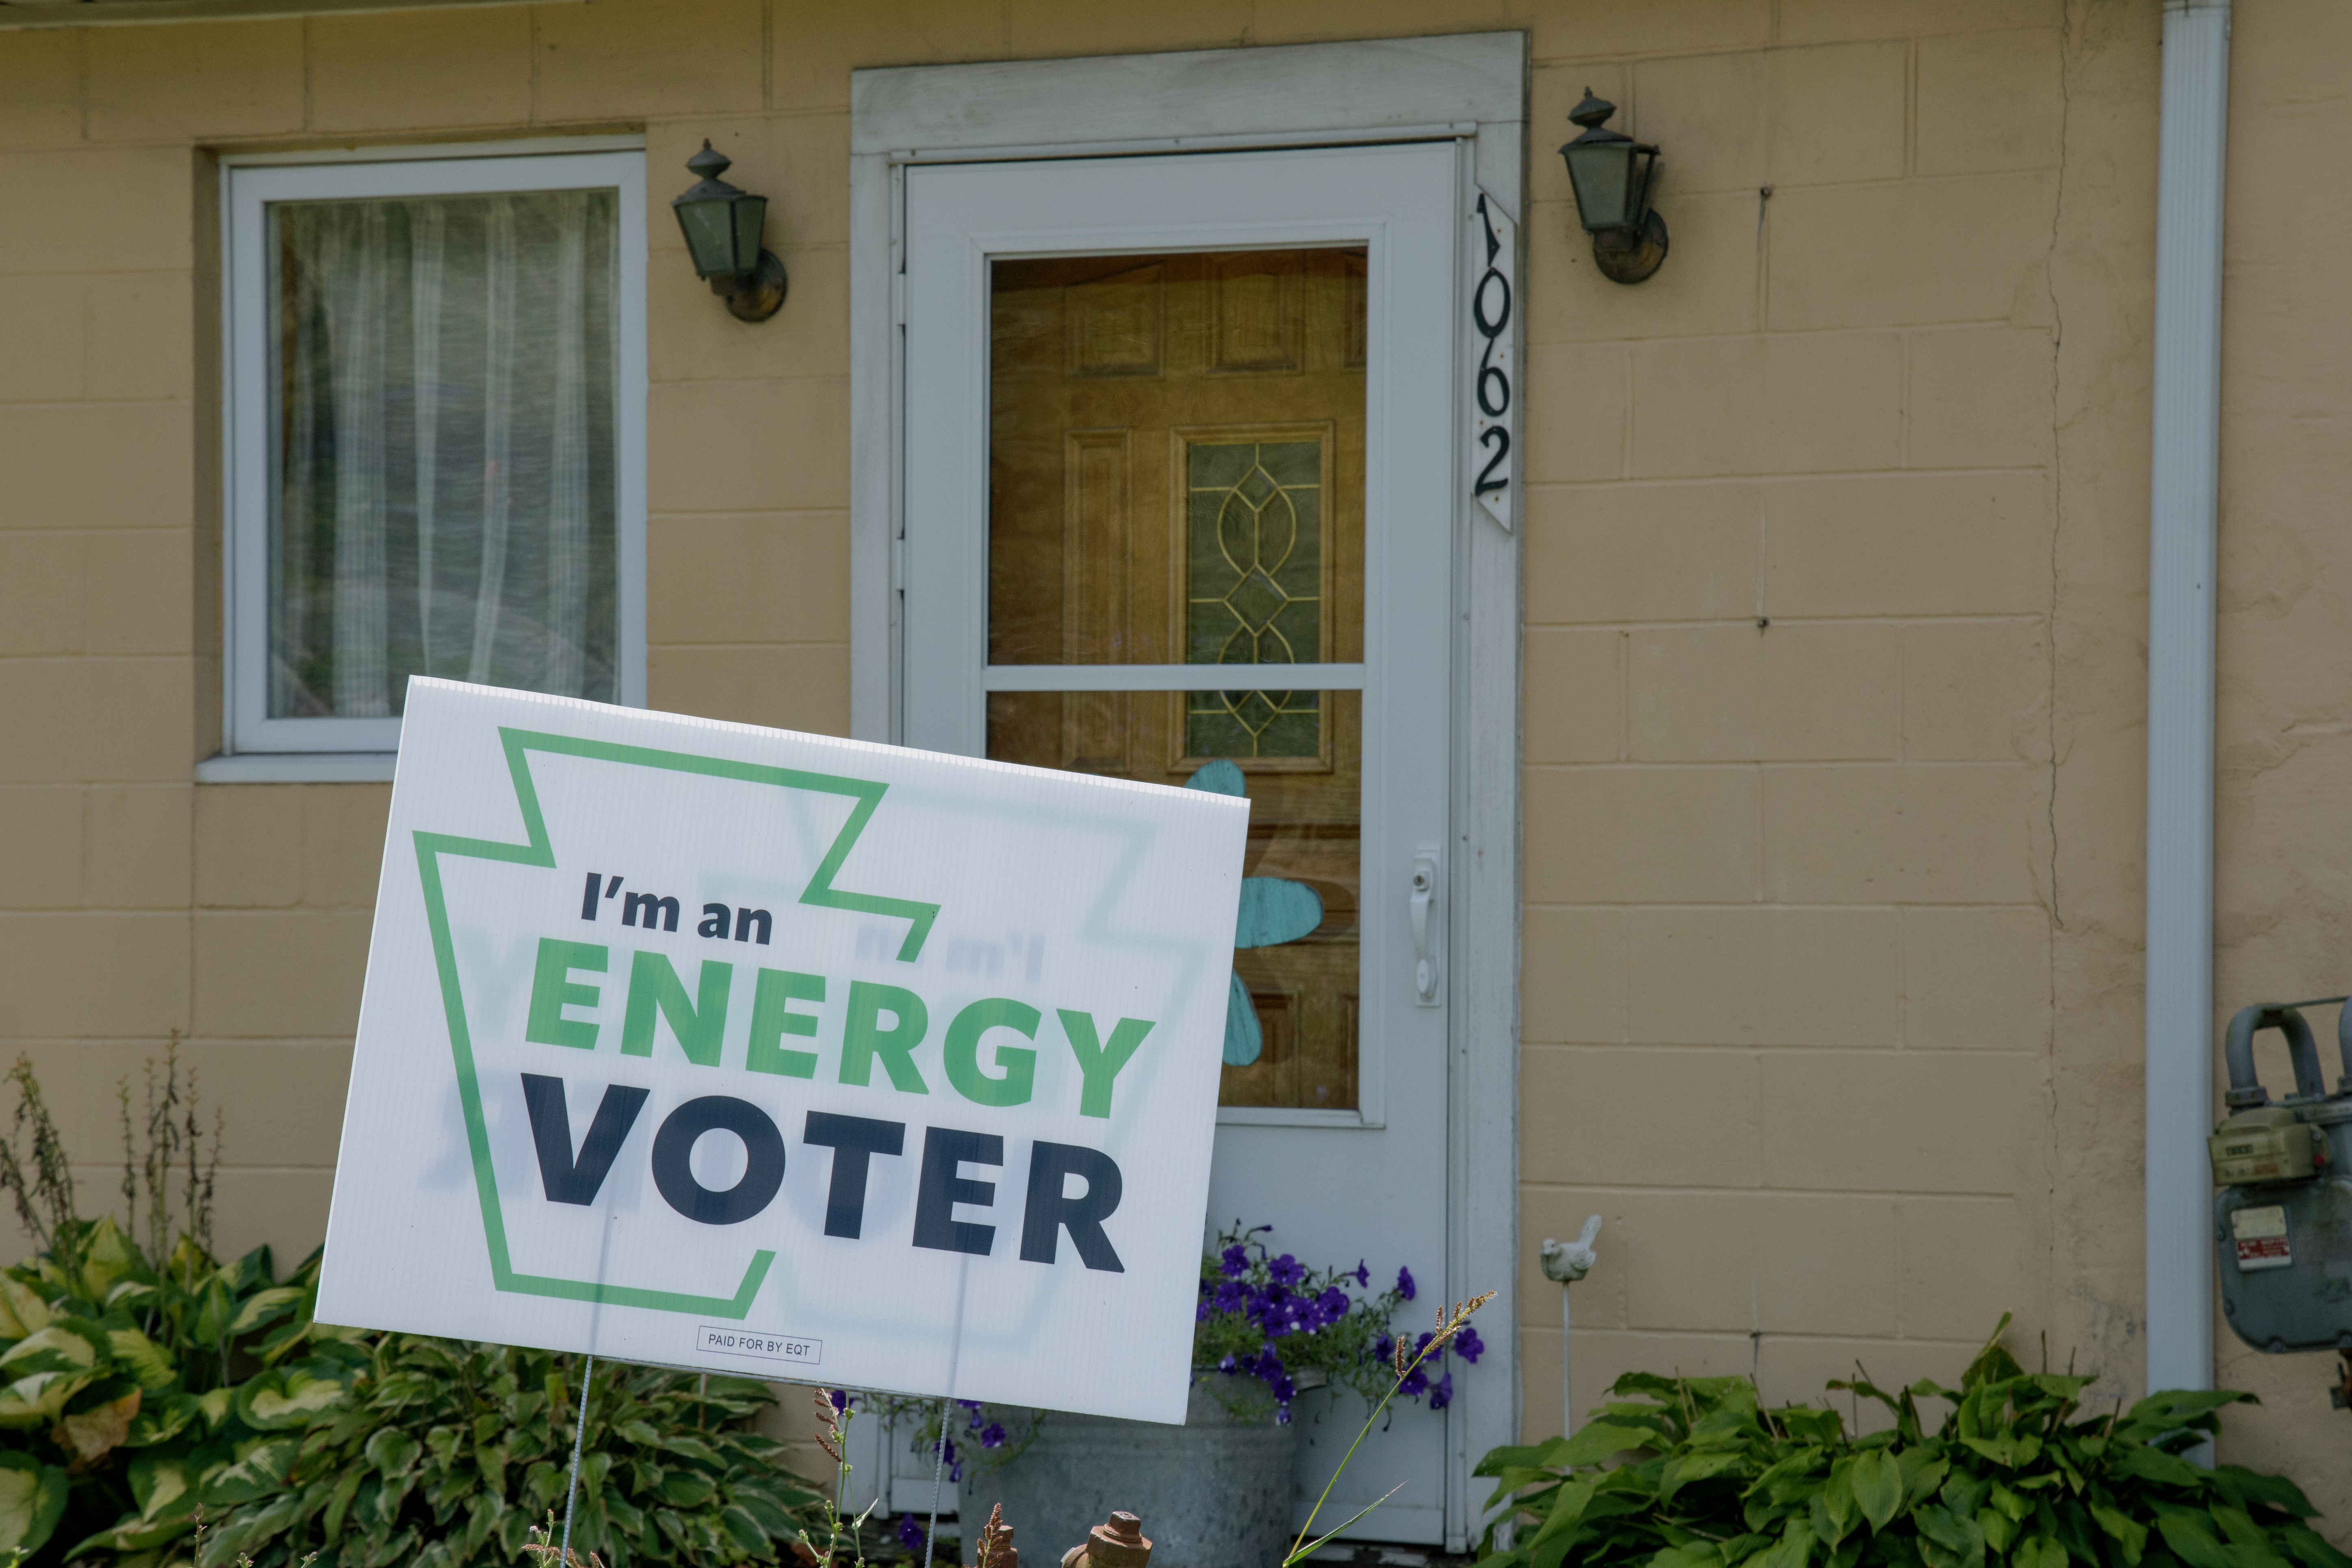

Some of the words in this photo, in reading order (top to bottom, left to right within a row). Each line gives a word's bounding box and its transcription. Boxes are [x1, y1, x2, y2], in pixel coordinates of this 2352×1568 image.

[1473, 193, 1511, 497] 1062
[581, 872, 680, 932] I'm
[697, 903, 772, 945] an
[526, 937, 1156, 1119] ENERGY
[520, 1072, 1125, 1273] VOTER
[708, 1334, 735, 1347] PAID
[738, 1337, 763, 1351] FOR
[767, 1341, 783, 1353] BY
[786, 1343, 810, 1356] EQT
